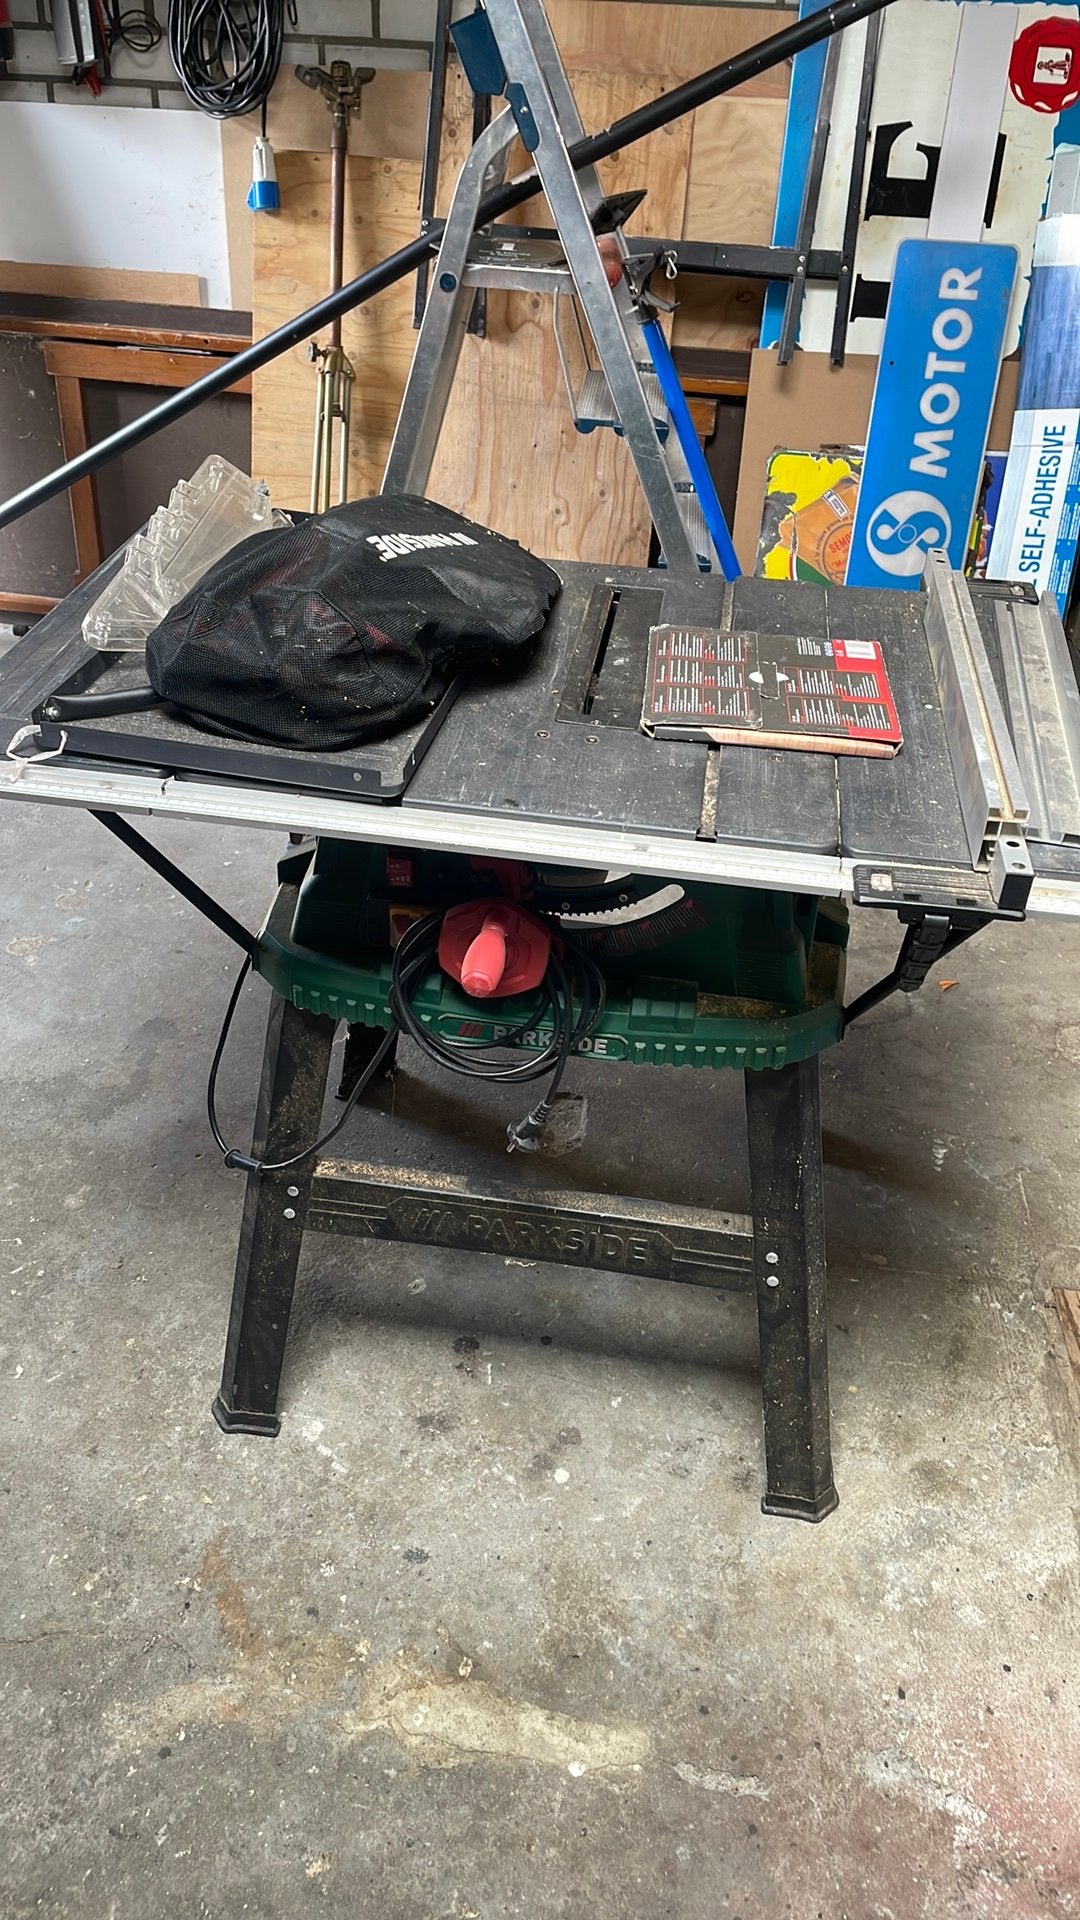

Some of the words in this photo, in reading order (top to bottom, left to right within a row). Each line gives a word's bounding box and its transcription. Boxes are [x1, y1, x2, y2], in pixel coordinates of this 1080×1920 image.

[910, 267, 983, 479] MOTOR
[1018, 425, 1066, 573] SELF-ADHESIVE
[829, 532, 852, 553] SEMO
[493, 1025, 608, 1055] PRKDE
[466, 1214, 648, 1260] PARKSIDE
